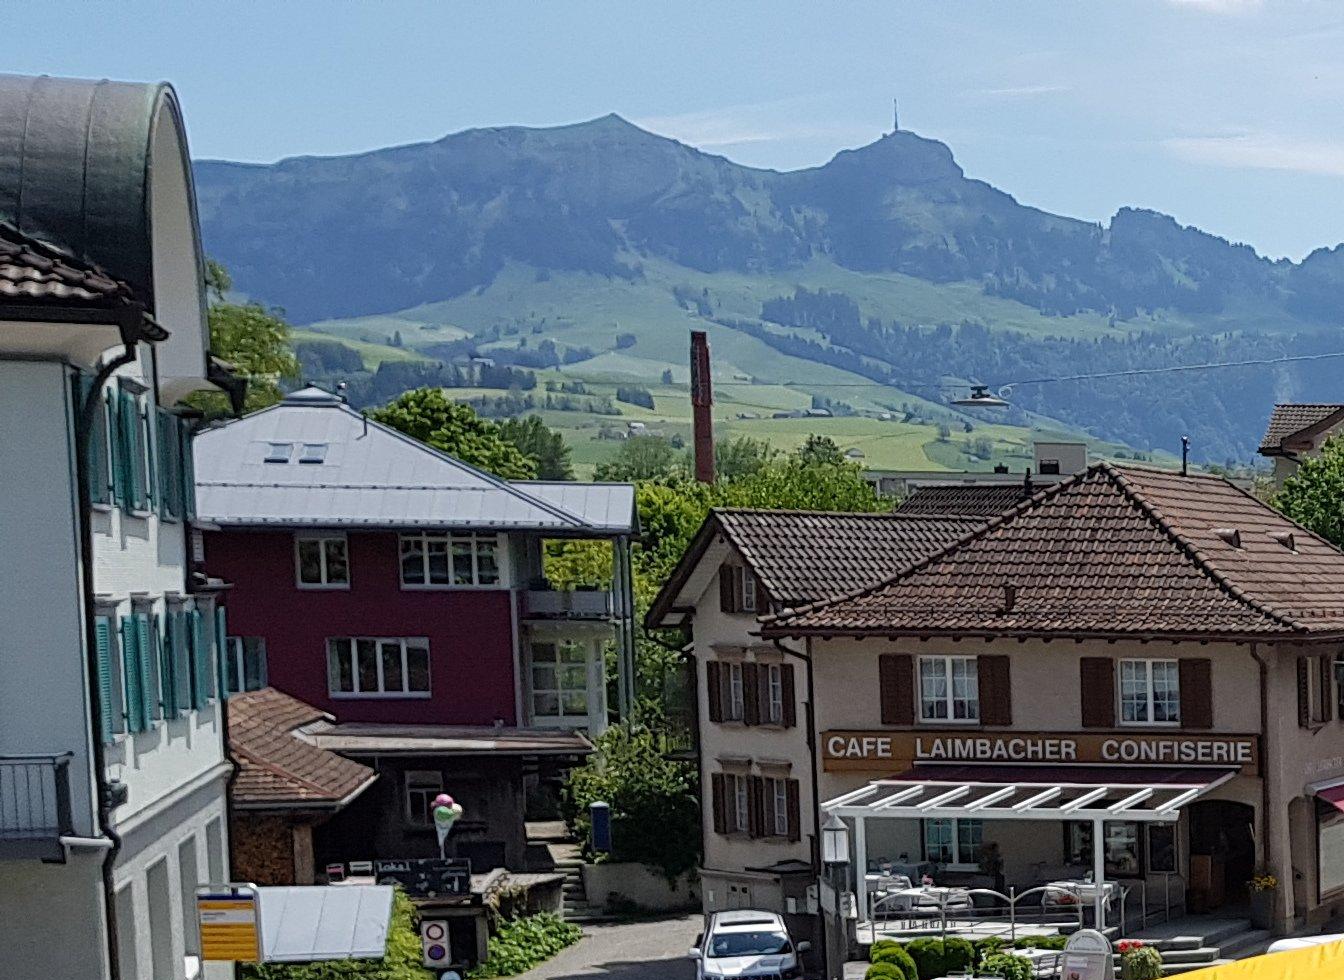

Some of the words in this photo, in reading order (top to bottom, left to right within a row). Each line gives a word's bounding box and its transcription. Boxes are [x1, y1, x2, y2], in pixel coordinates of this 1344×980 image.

[828, 736, 891, 758] CAFE
[916, 738, 1077, 760] LAIMBACHER
[1101, 740, 1252, 762] CONFISERIE
